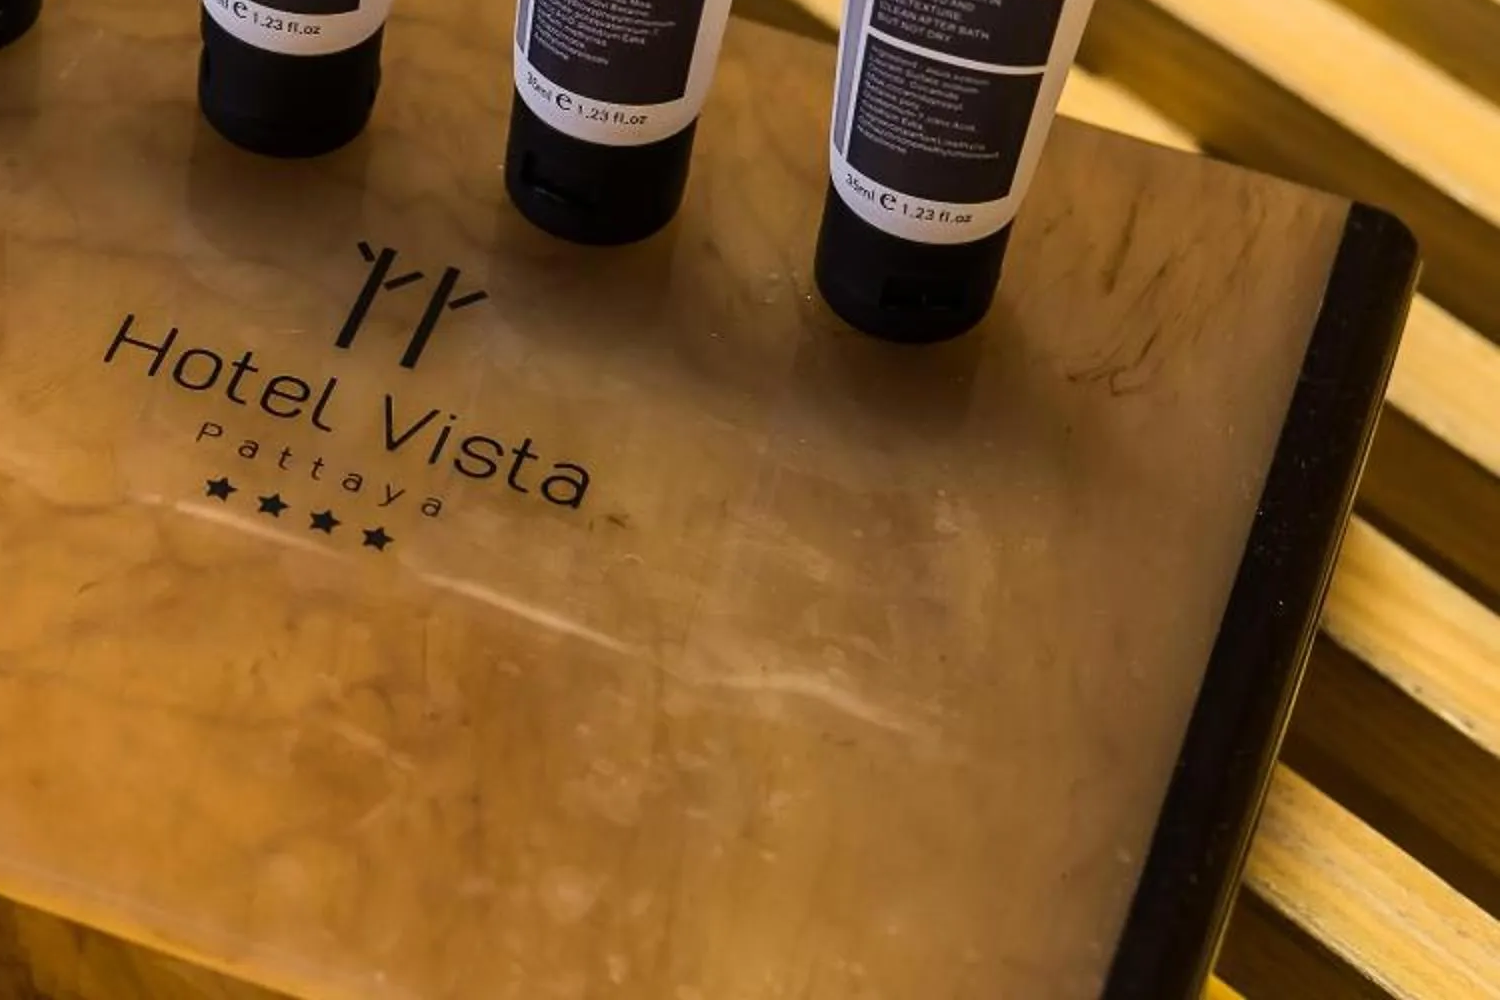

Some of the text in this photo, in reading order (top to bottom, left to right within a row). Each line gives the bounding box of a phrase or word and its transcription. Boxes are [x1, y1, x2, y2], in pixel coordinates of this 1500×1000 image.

[253, 12, 283, 31] 1.23
[287, 20, 322, 35] fl.oz
[901, 20, 925, 36] NOT
[927, 30, 951, 43] DRY
[918, 13, 957, 33] AFTER
[958, 25, 990, 41] BATH
[577, 104, 609, 122] 1.23
[613, 111, 649, 125] fl.oz
[903, 203, 935, 221] 1.23
[939, 211, 973, 223] fl.oz
[103, 312, 592, 509] Hotel Vista
[196, 420, 443, 518] Pattaya
